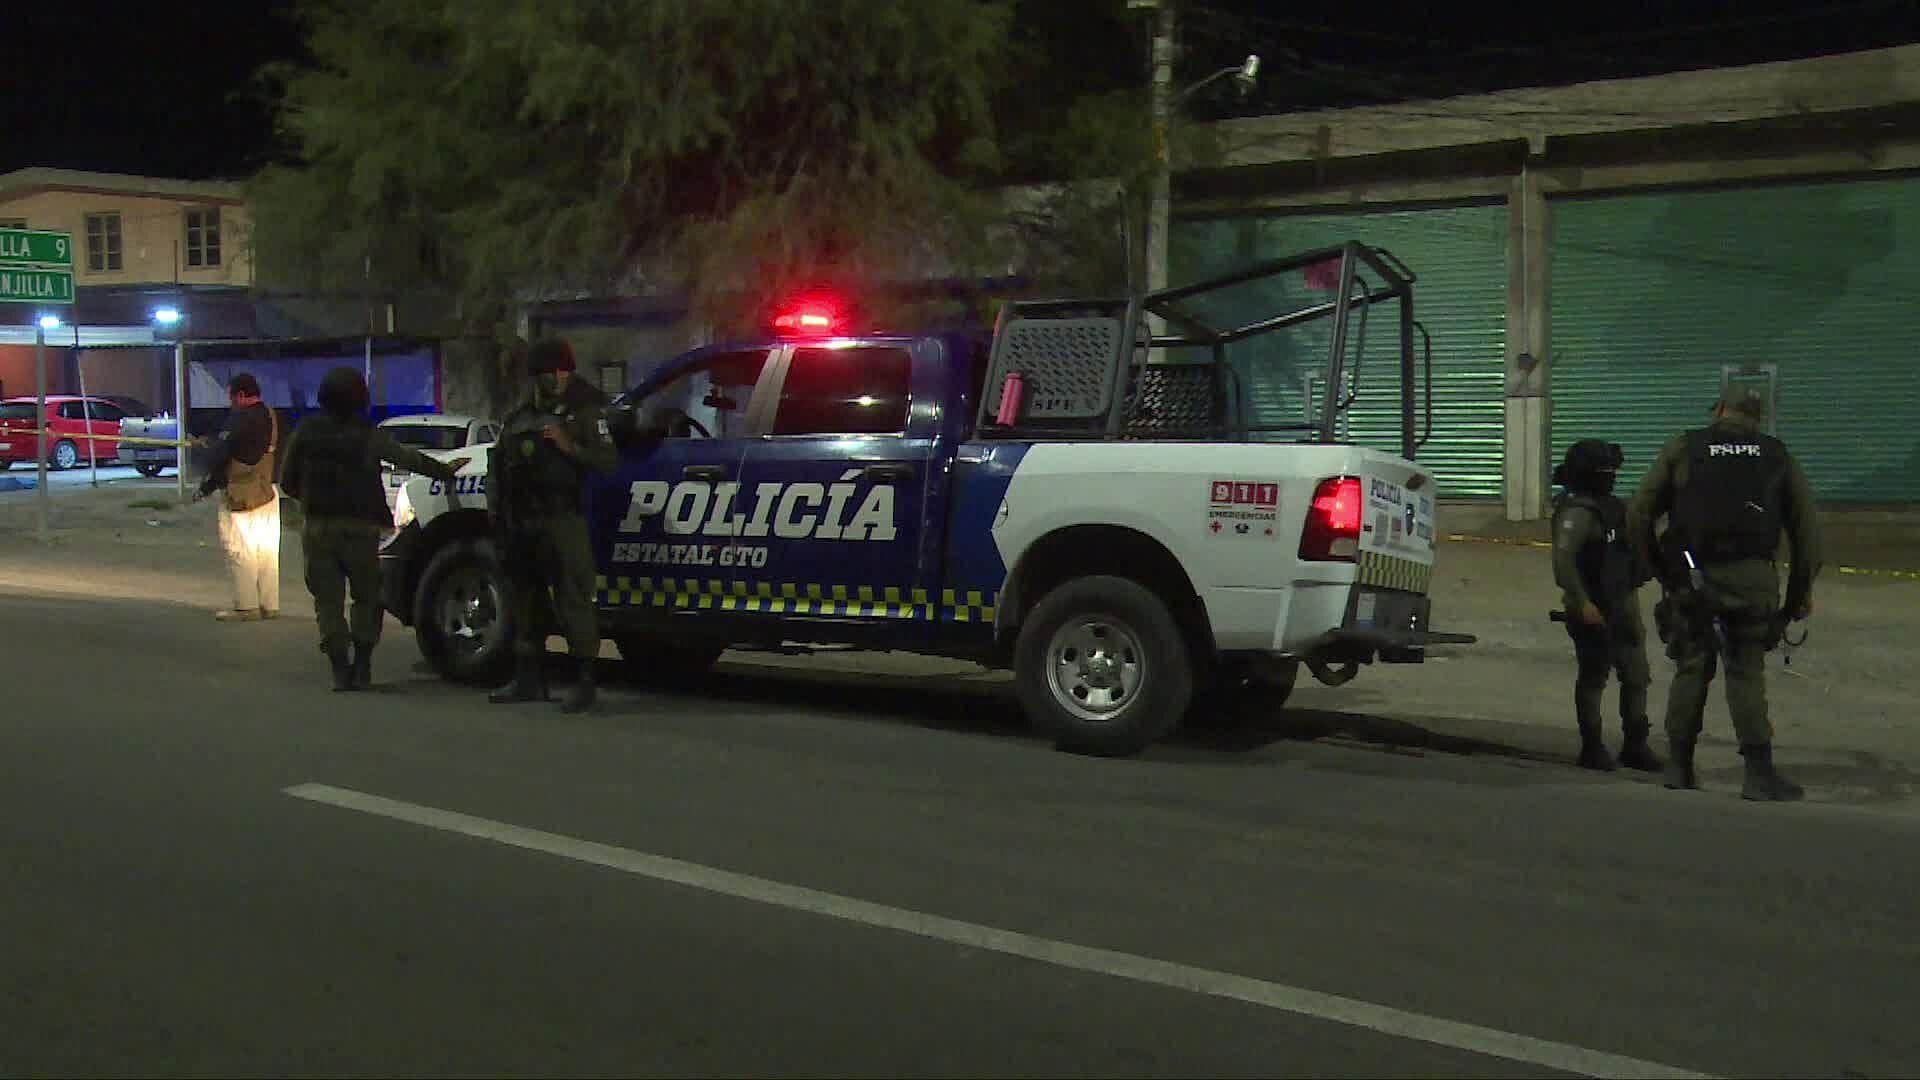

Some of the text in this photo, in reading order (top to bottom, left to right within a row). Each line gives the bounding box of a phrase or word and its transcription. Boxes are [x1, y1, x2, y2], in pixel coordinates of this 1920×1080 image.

[0, 234, 66, 259] LLA 9
[63, 277, 68, 297] 1
[617, 468, 898, 541] POLICÍA
[1208, 511, 1277, 521] EMERGENCIAS
[611, 543, 768, 568] ESTATAL GTO
